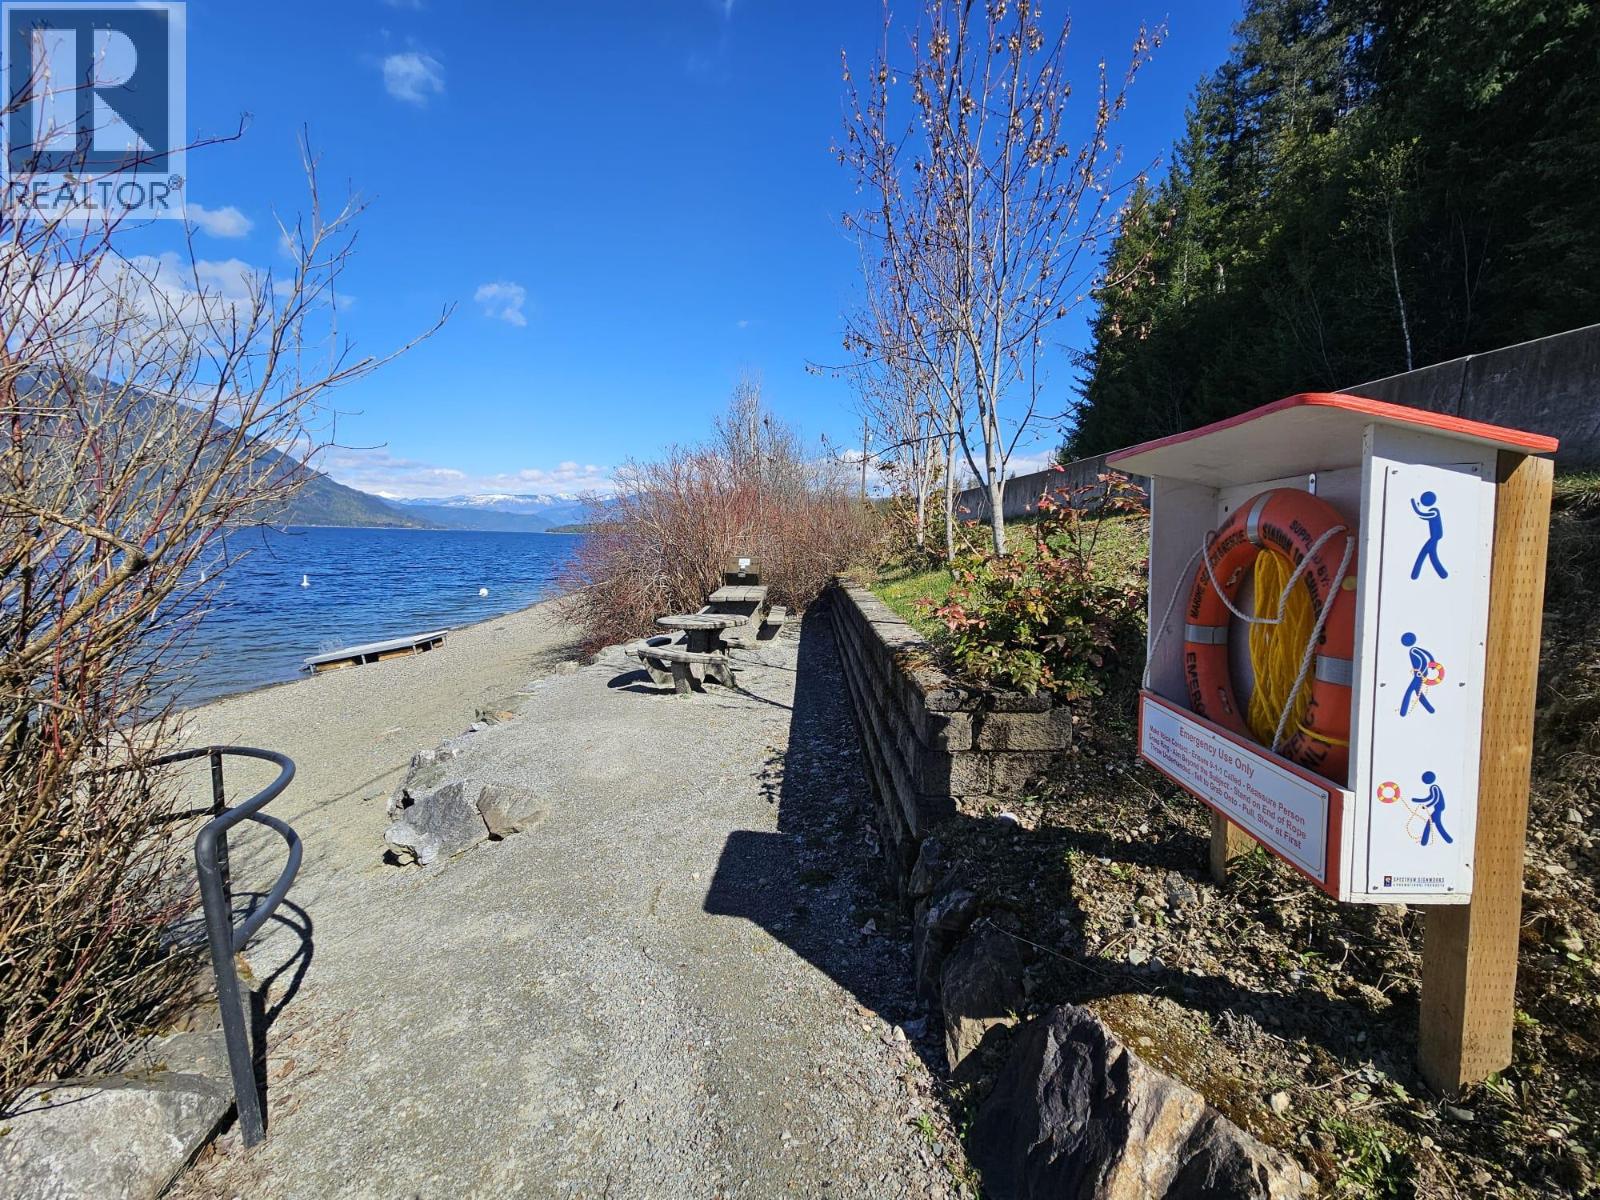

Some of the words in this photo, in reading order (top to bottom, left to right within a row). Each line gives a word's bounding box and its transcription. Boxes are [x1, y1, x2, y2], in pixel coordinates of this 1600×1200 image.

[1180, 726, 1216, 757] Emergency
[1219, 747, 1233, 764] Use
[1235, 757, 1255, 778] Only
[1246, 783, 1277, 808] Reassure
[1278, 802, 1305, 825] Person
[1252, 800, 1261, 810] on
[1262, 804, 1276, 820] End
[1277, 816, 1285, 825] of
[1286, 819, 1307, 840] Rope
[1257, 813, 1275, 830] Slow
[1275, 826, 1283, 837] at
[1283, 831, 1302, 850] First
